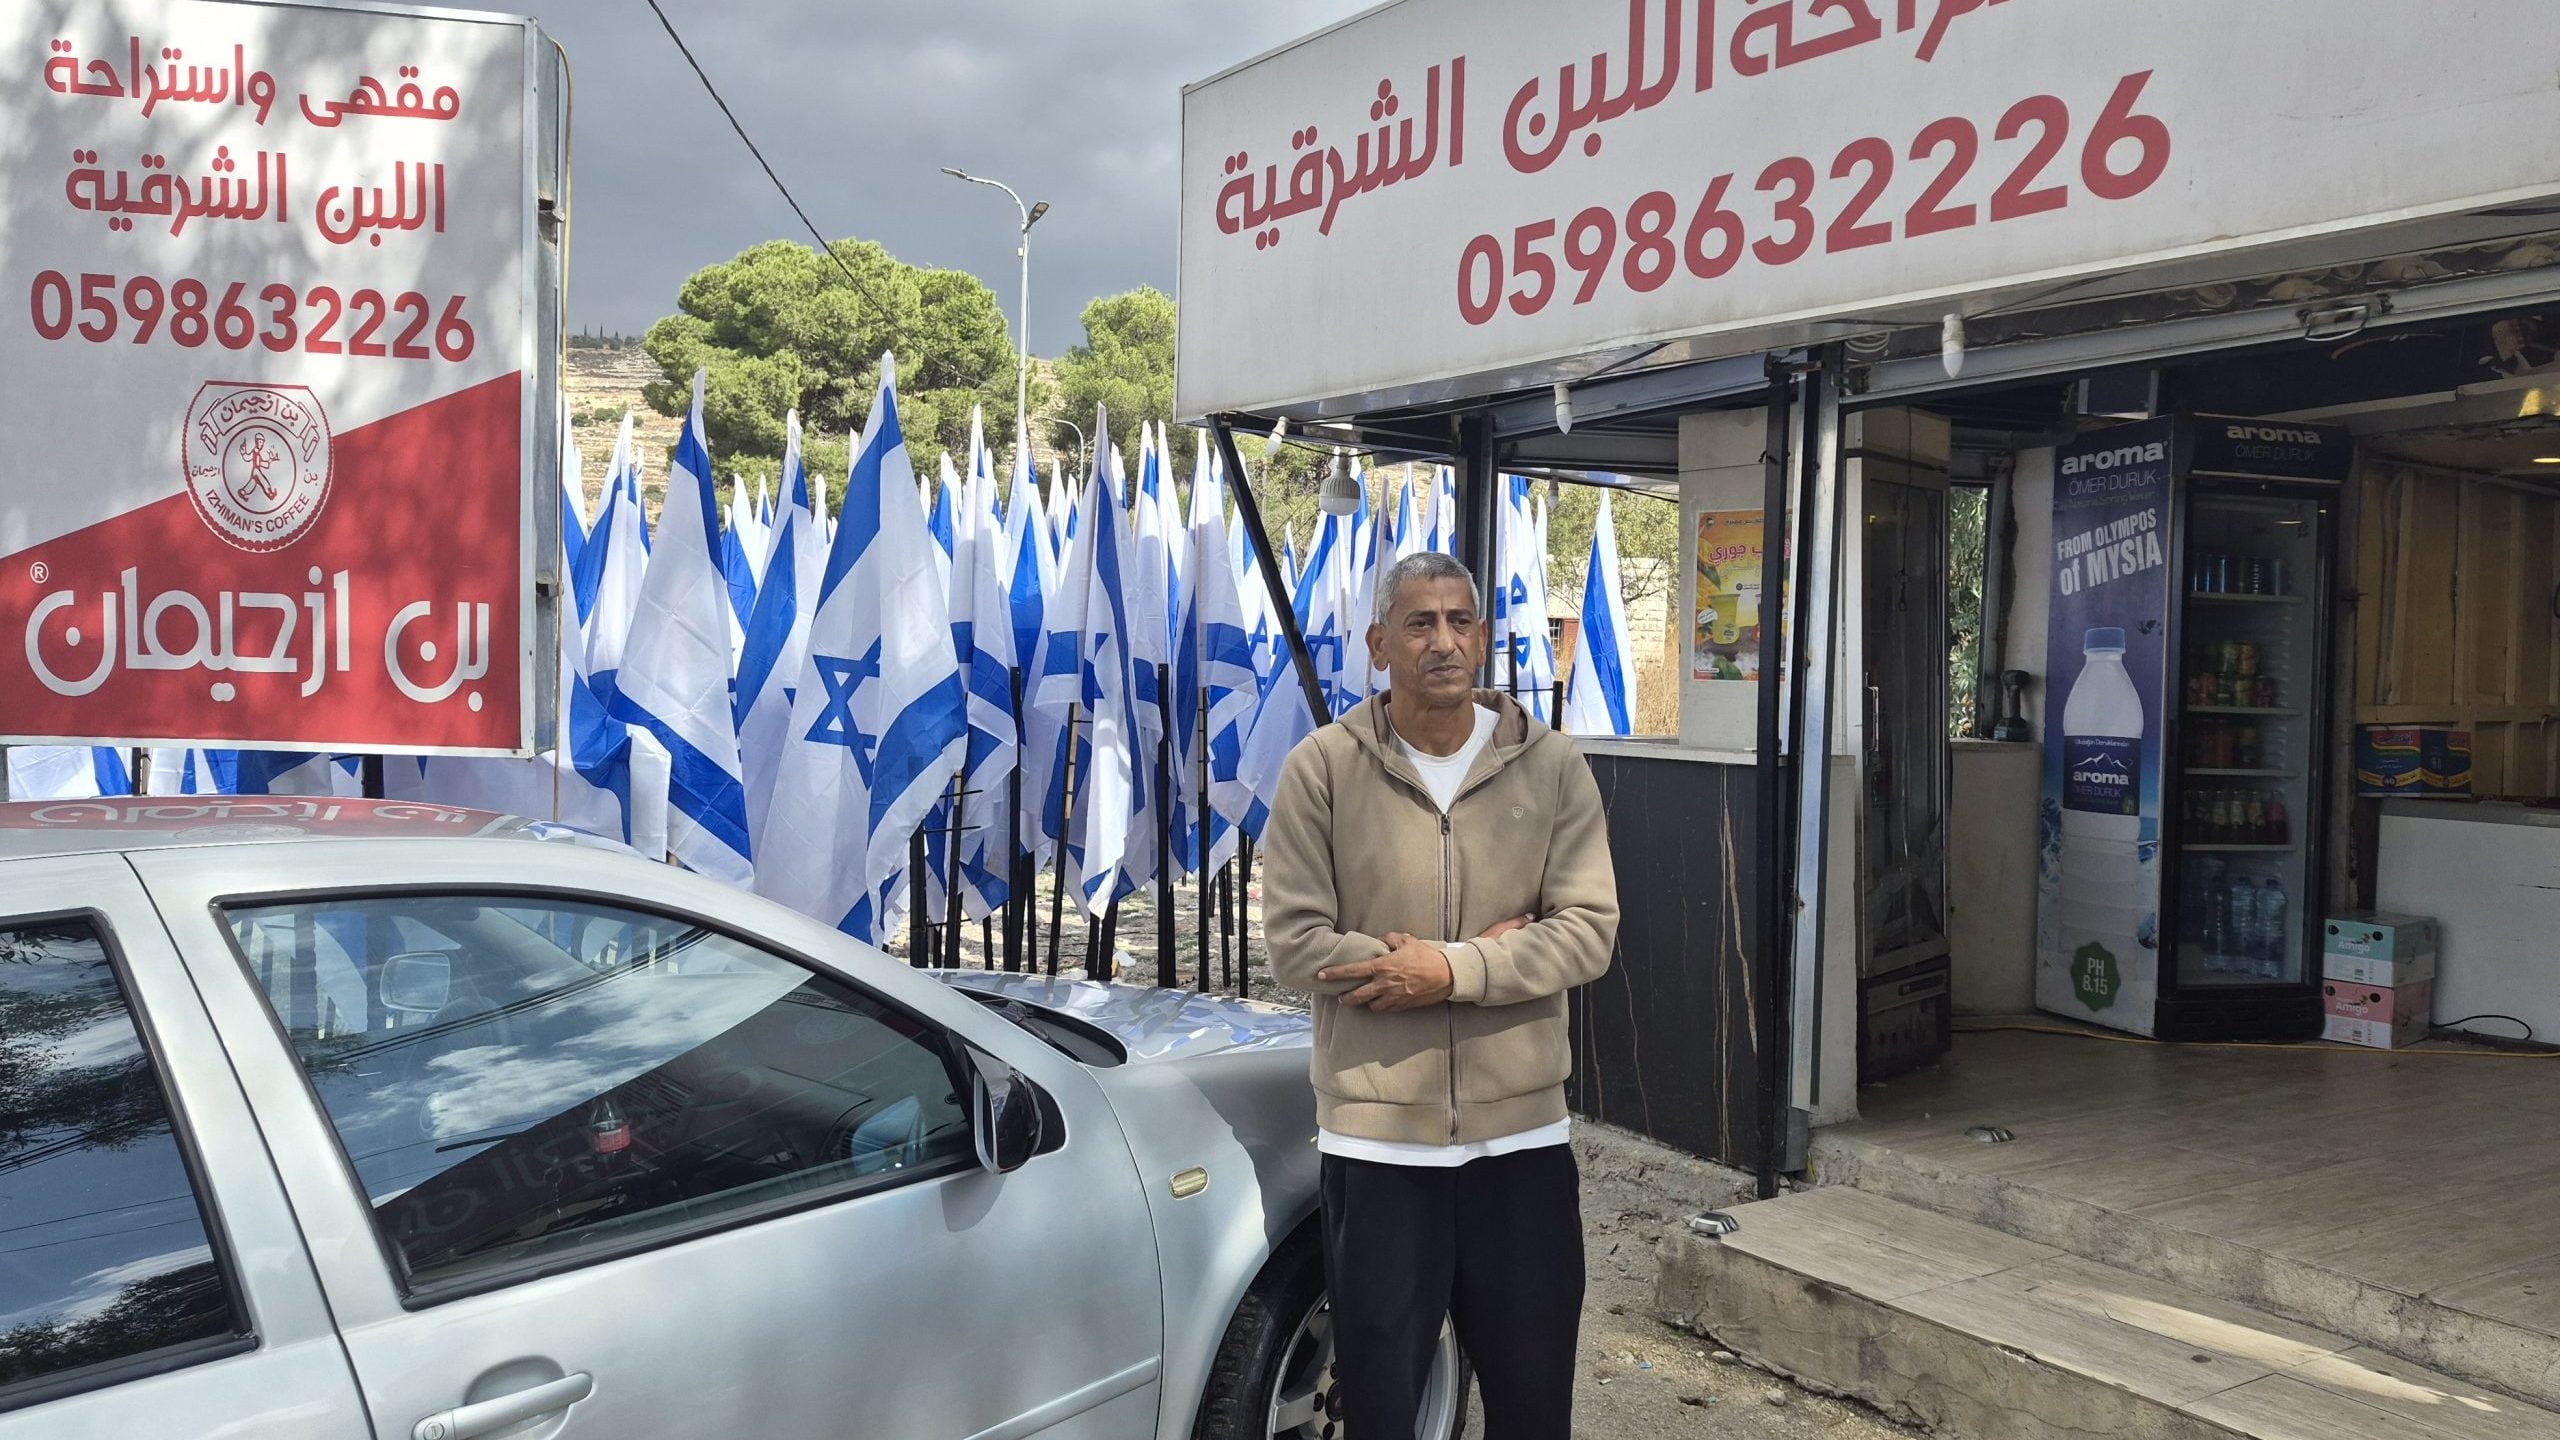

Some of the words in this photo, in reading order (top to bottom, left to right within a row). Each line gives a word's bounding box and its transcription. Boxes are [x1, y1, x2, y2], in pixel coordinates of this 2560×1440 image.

[44, 36, 277, 126] واستراحة
[299, 65, 461, 128] مقهى
[1504, 0, 1716, 174] اللبن
[66, 145, 288, 238] الشرقية
[1217, 60, 1465, 251] الشرقية
[1458, 72, 2170, 325] 0598632226
[315, 160, 446, 247] اللبن
[30, 271, 476, 363] 0598632226
[2061, 442, 2165, 475] aroma
[2226, 425, 2322, 444] aroma
[206, 489, 263, 533] IZHIMAN'S
[265, 493, 310, 532] COFFEE
[2057, 530, 2093, 561] FROM
[2095, 507, 2157, 547] OLYMPOS
[2060, 557, 2081, 596] of
[2086, 530, 2163, 588] MYSIA
[24, 566, 351, 703] ازحيمان
[384, 600, 490, 712] بن
[2072, 770, 2130, 786] aroma
[2087, 957, 2105, 977] PH
